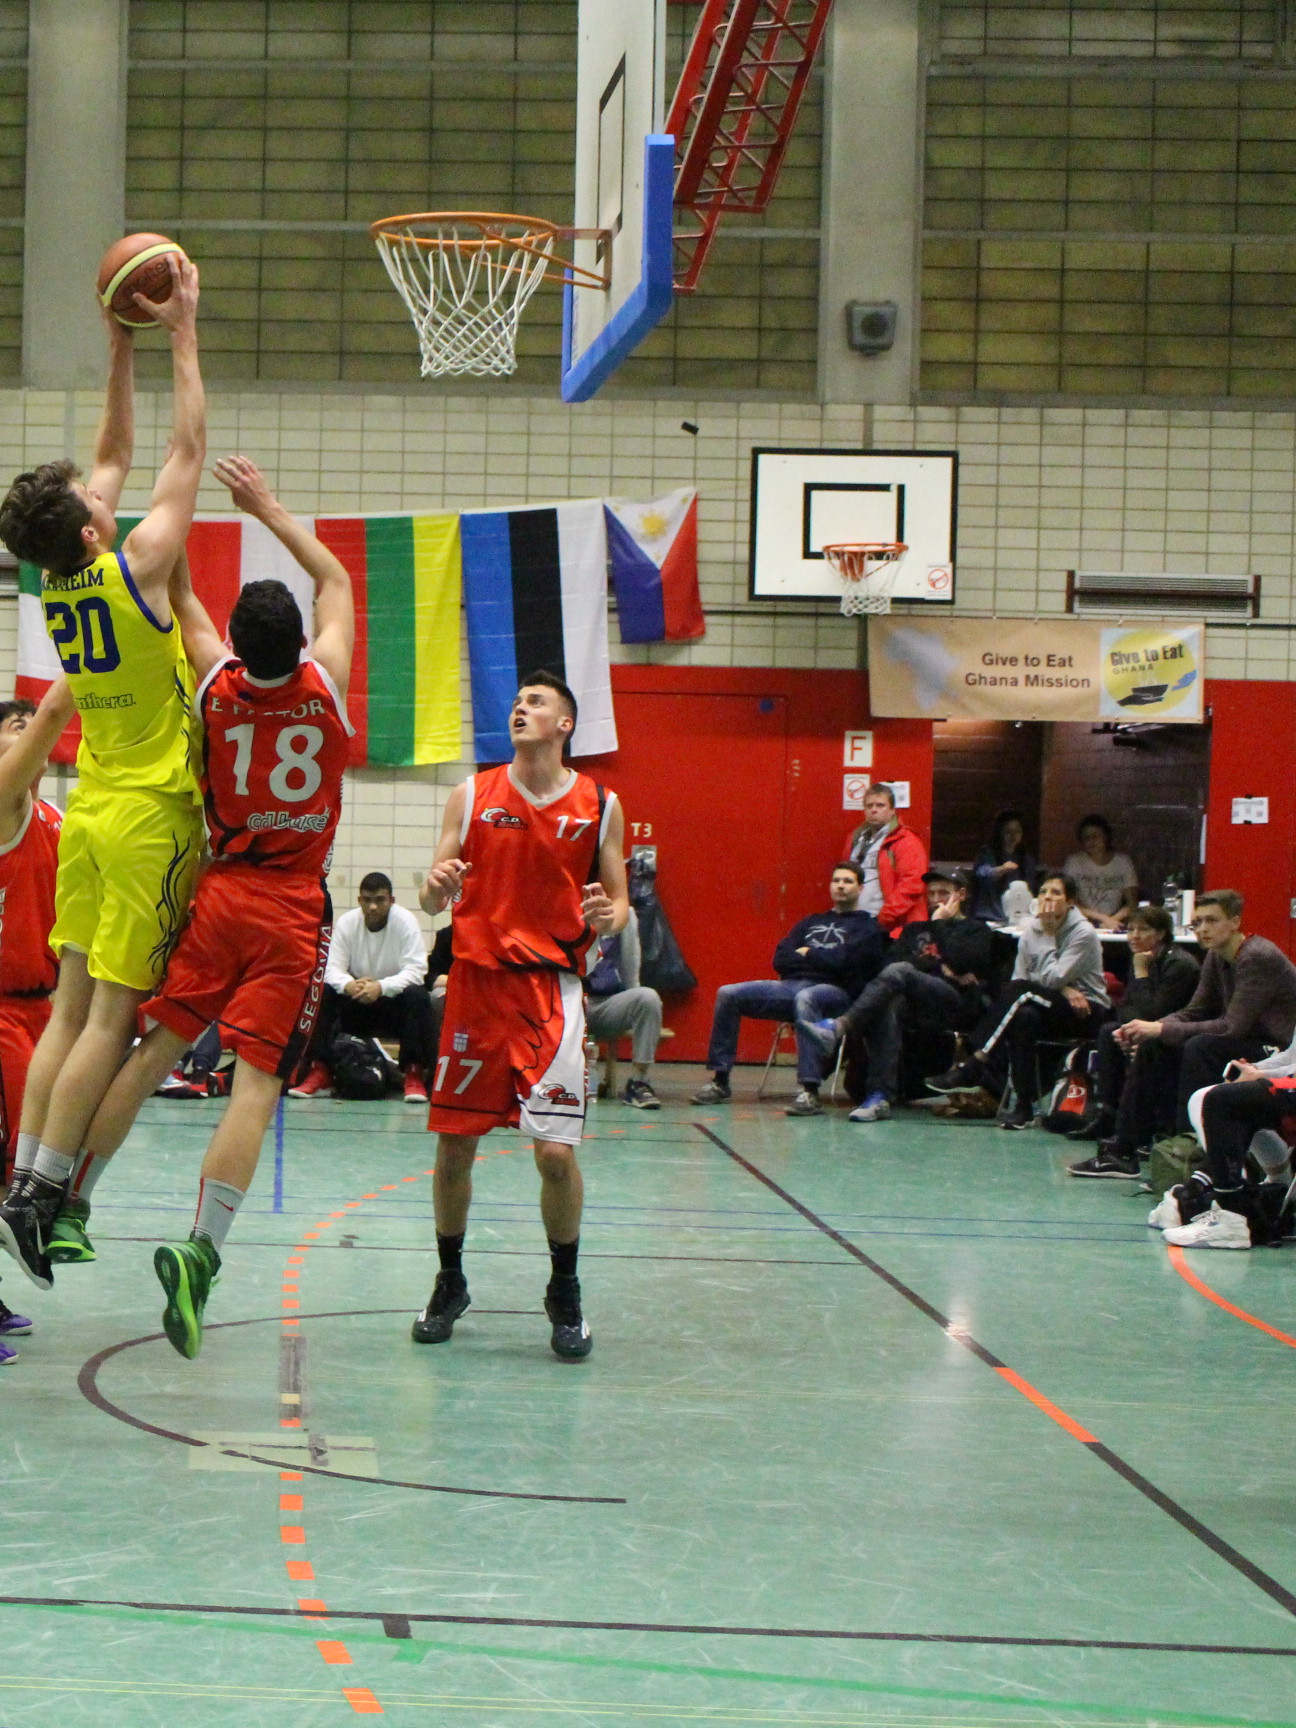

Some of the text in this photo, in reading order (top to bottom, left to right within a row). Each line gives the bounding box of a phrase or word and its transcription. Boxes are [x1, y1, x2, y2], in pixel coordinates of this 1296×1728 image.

[45, 596, 121, 674] 20
[981, 652, 1074, 668] Give to Eat
[1111, 643, 1185, 667] Give to Eat
[1111, 662, 1154, 675] GHANA
[964, 671, 1091, 688] Ghana Mission
[849, 735, 867, 762] F
[224, 723, 324, 802] 18
[556, 815, 593, 842] 17
[300, 924, 334, 1033] SEGOVIA
[434, 1055, 483, 1095] 17
